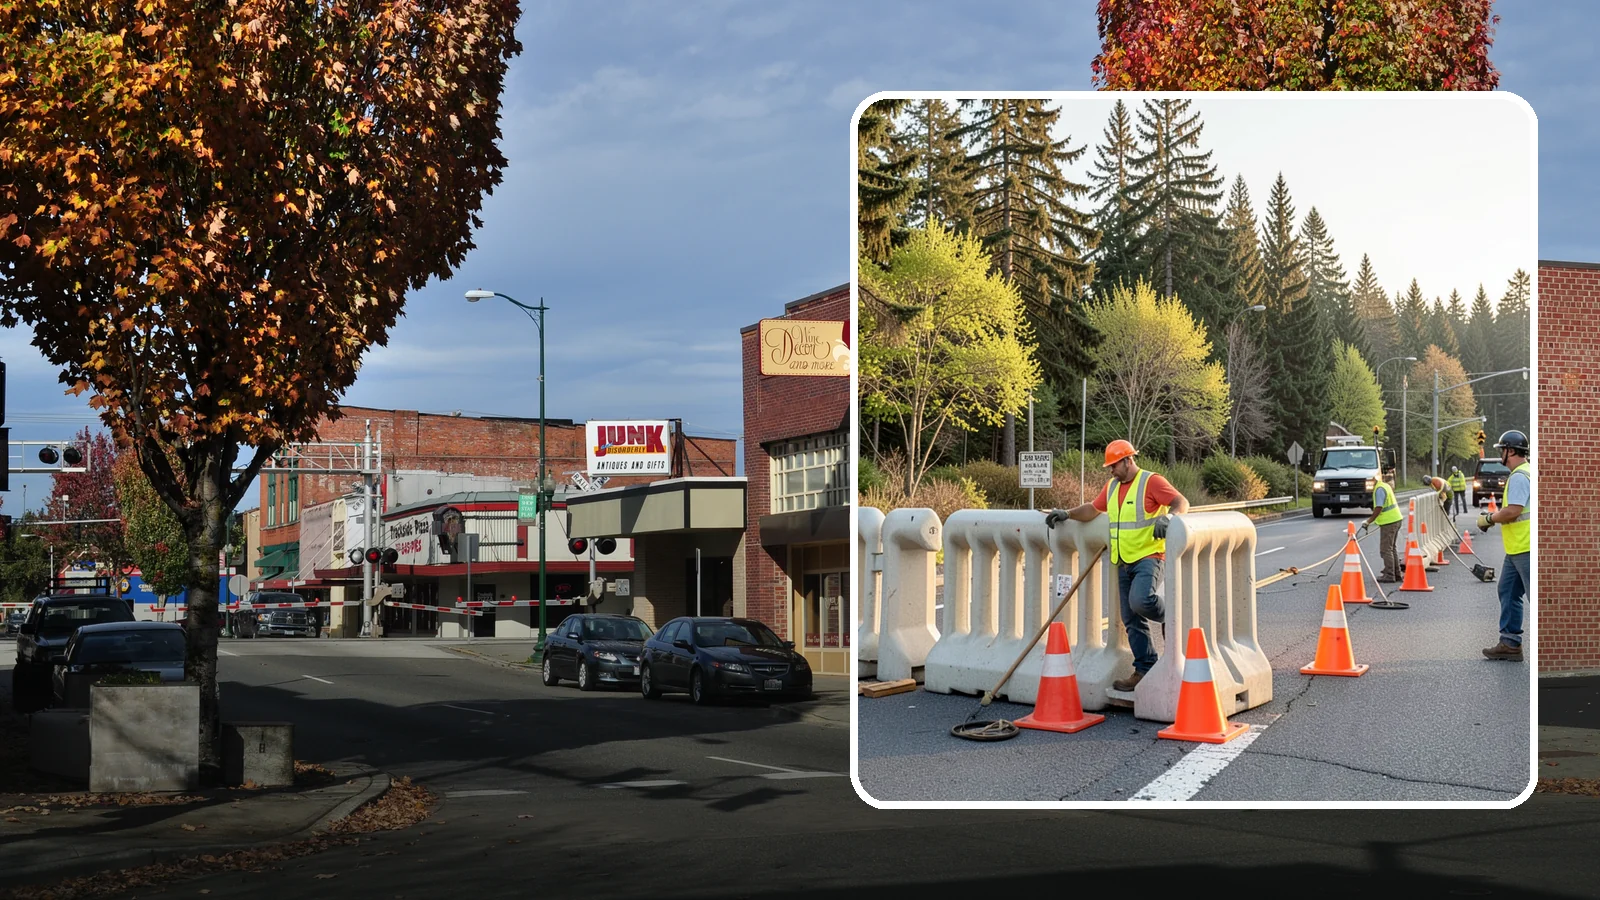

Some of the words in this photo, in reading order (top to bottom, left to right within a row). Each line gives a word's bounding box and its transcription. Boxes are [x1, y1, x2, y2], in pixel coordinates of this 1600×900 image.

[595, 425, 665, 457] JUNK
[607, 446, 645, 454] DISORDERLY
[597, 461, 628, 470] ANTIQUES
[631, 461, 644, 470] AND
[647, 460, 665, 470] GIFTS
[414, 519, 429, 535] Pizza
